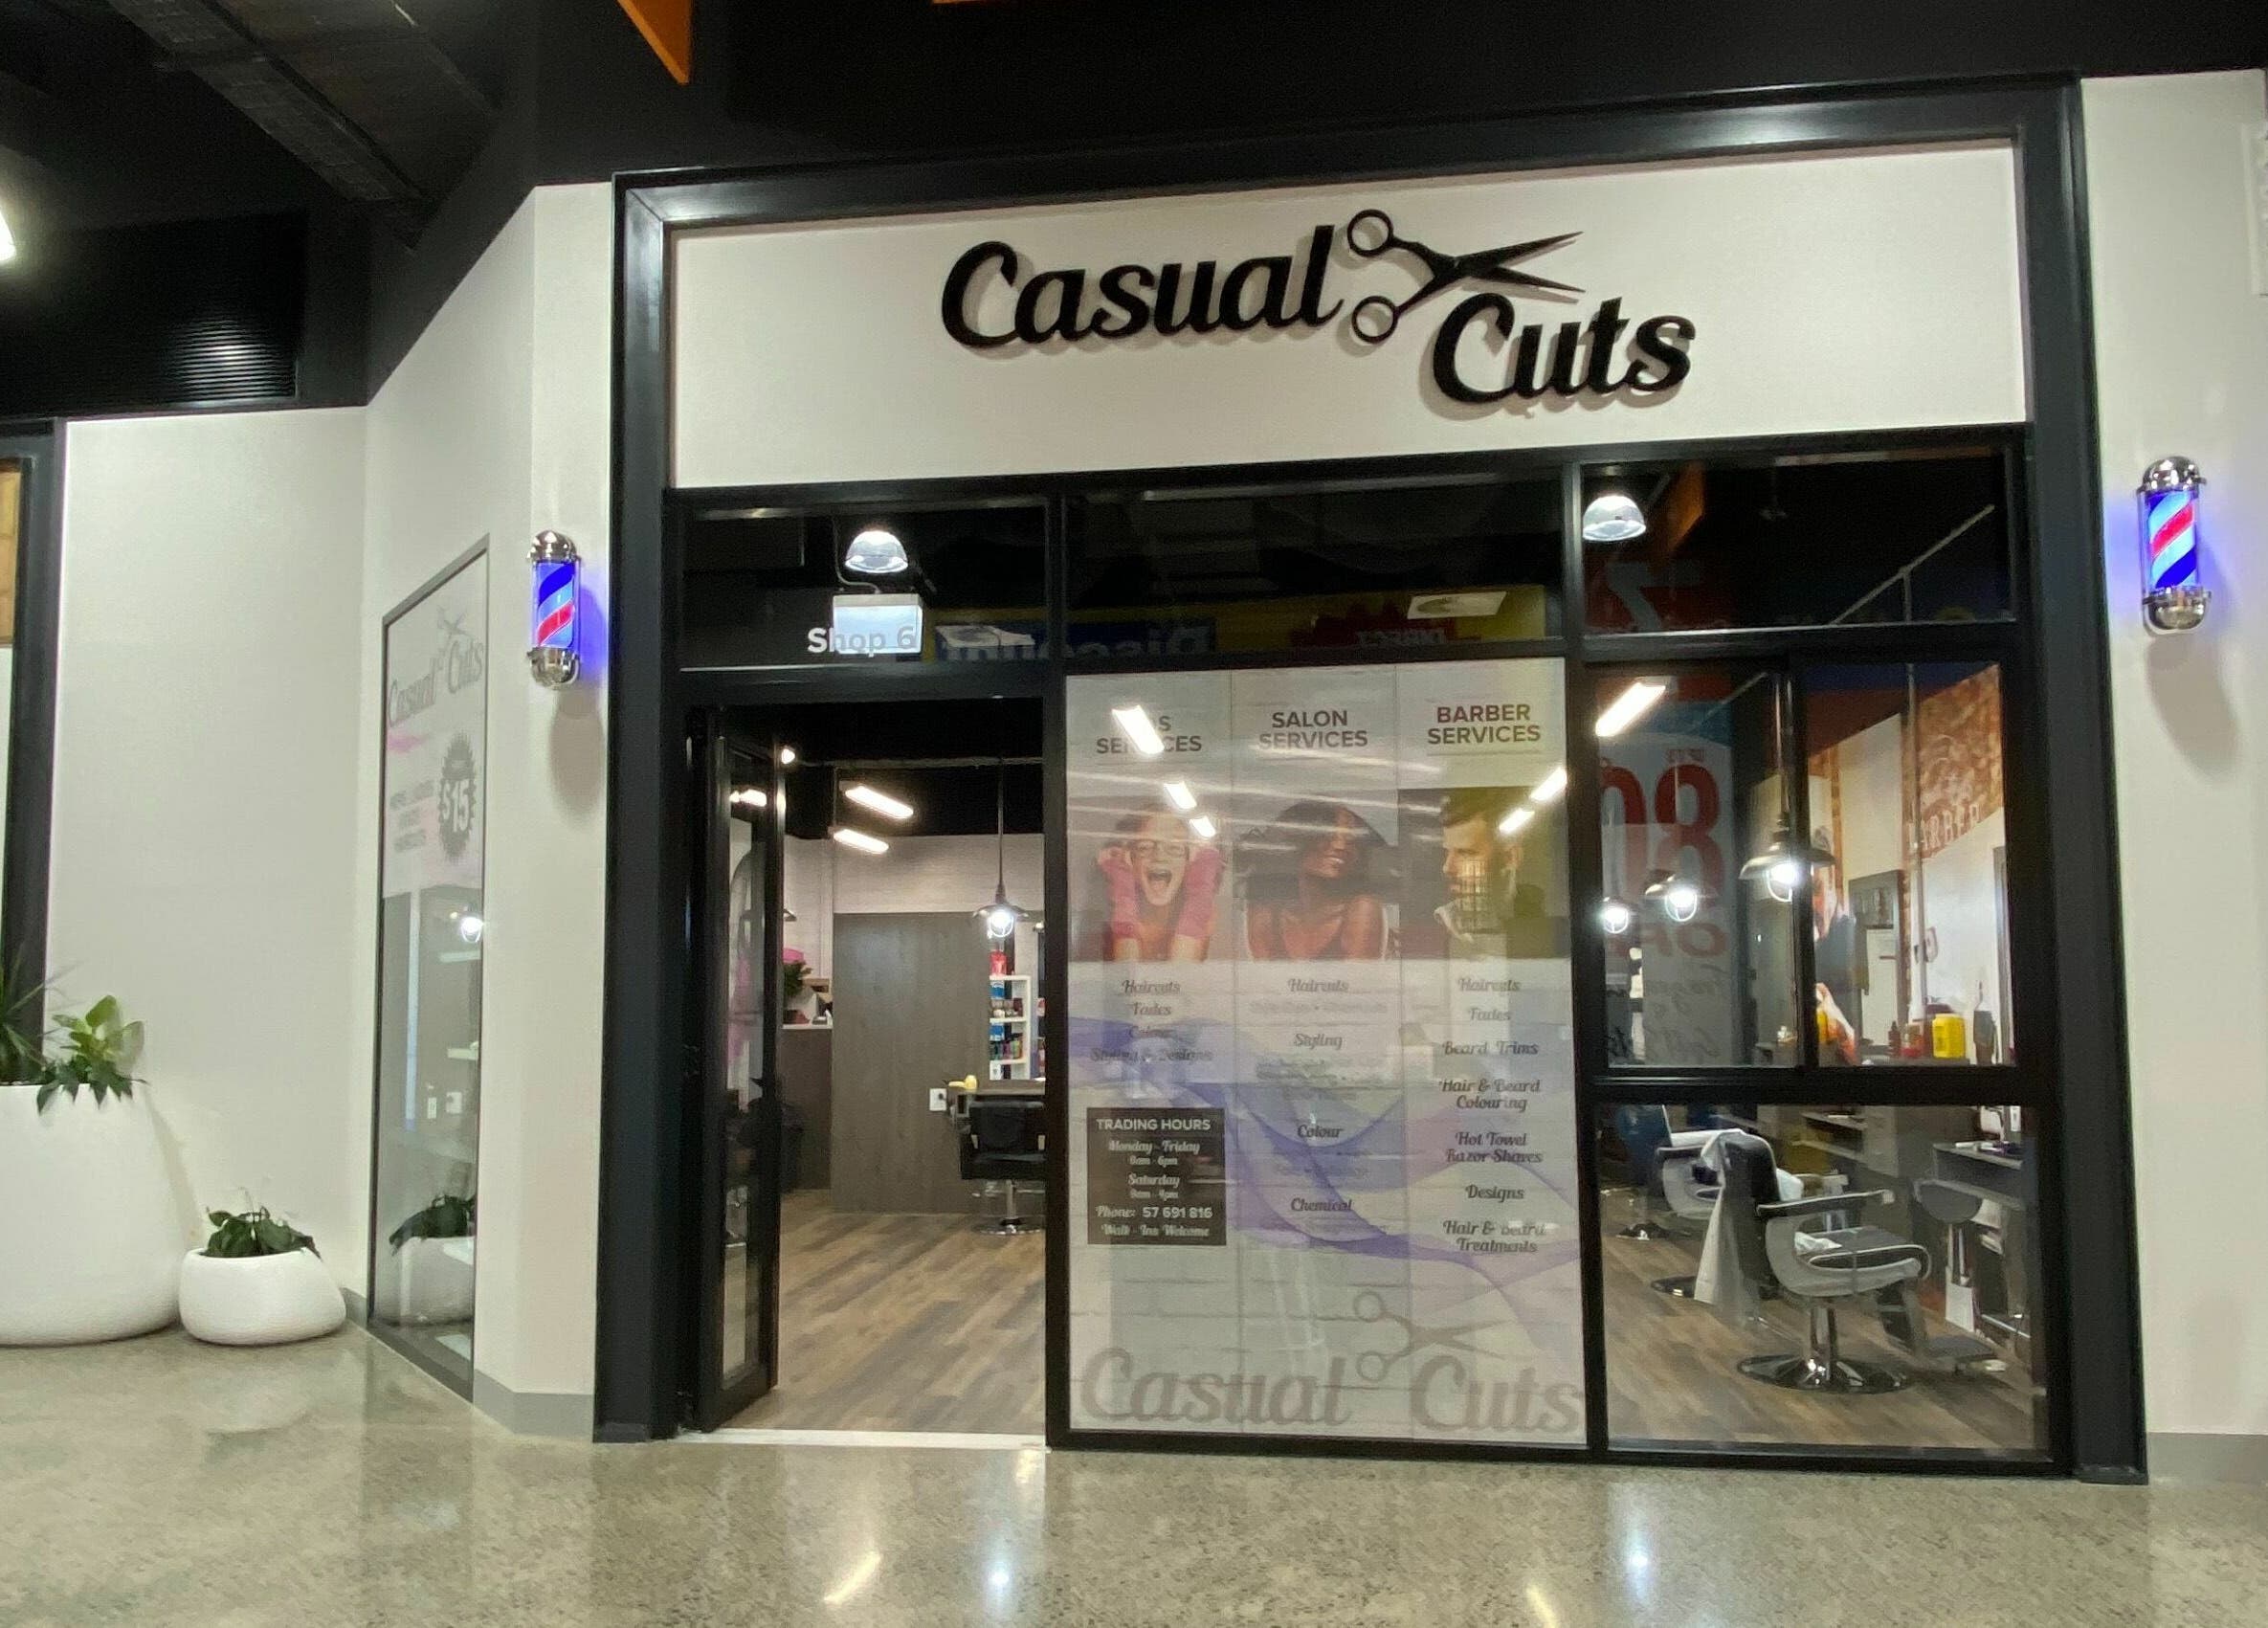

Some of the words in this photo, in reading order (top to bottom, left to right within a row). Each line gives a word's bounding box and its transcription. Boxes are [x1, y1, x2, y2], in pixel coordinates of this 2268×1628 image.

[941, 223, 1342, 348] Casual
[1431, 291, 1696, 405] Cuts
[807, 627, 886, 658] Shop
[897, 626, 917, 650] 6
[1272, 709, 1348, 728] SALON
[1436, 703, 1530, 725] BARBER
[1259, 730, 1368, 750] SERVICES
[1428, 725, 1541, 746] SERVICES
[1096, 735, 1202, 754] SECES
[440, 778, 470, 833] $15
[1122, 979, 1181, 994] Haircuts
[1287, 978, 1349, 992] Haircuts
[1457, 978, 1522, 992] Haircuts
[1294, 1033, 1344, 1050] Styling
[1442, 1040, 1487, 1055] Beard
[1496, 1040, 1540, 1055] Trims
[1439, 1079, 1476, 1093] Hair
[1478, 1079, 1491, 1092] &
[1494, 1079, 1542, 1093] Beard
[1456, 1096, 1528, 1113] Colouring
[1096, 1118, 1158, 1131] TRADING
[1161, 1118, 1212, 1130] HOURS
[1297, 1124, 1345, 1138] Colour
[1108, 1139, 1153, 1154] Monday
[1161, 1139, 1201, 1154] Friday
[1455, 1131, 1482, 1147] Hot
[1486, 1131, 1528, 1147] Towel
[1446, 1150, 1490, 1164] Razor
[1494, 1150, 1544, 1164] Shaves
[1127, 1172, 1181, 1188] Saturday
[1465, 1185, 1524, 1203] Designs
[1095, 1205, 1136, 1217] Phone:
[1143, 1206, 1159, 1217] 57
[1163, 1206, 1187, 1217] 691
[1291, 1197, 1352, 1212] Chemical
[1442, 1220, 1479, 1236] Hair
[1482, 1220, 1495, 1236] &
[1456, 1238, 1539, 1253] Treatments
[1080, 1347, 1353, 1427] Casual
[1411, 1354, 1584, 1434] Cuts
